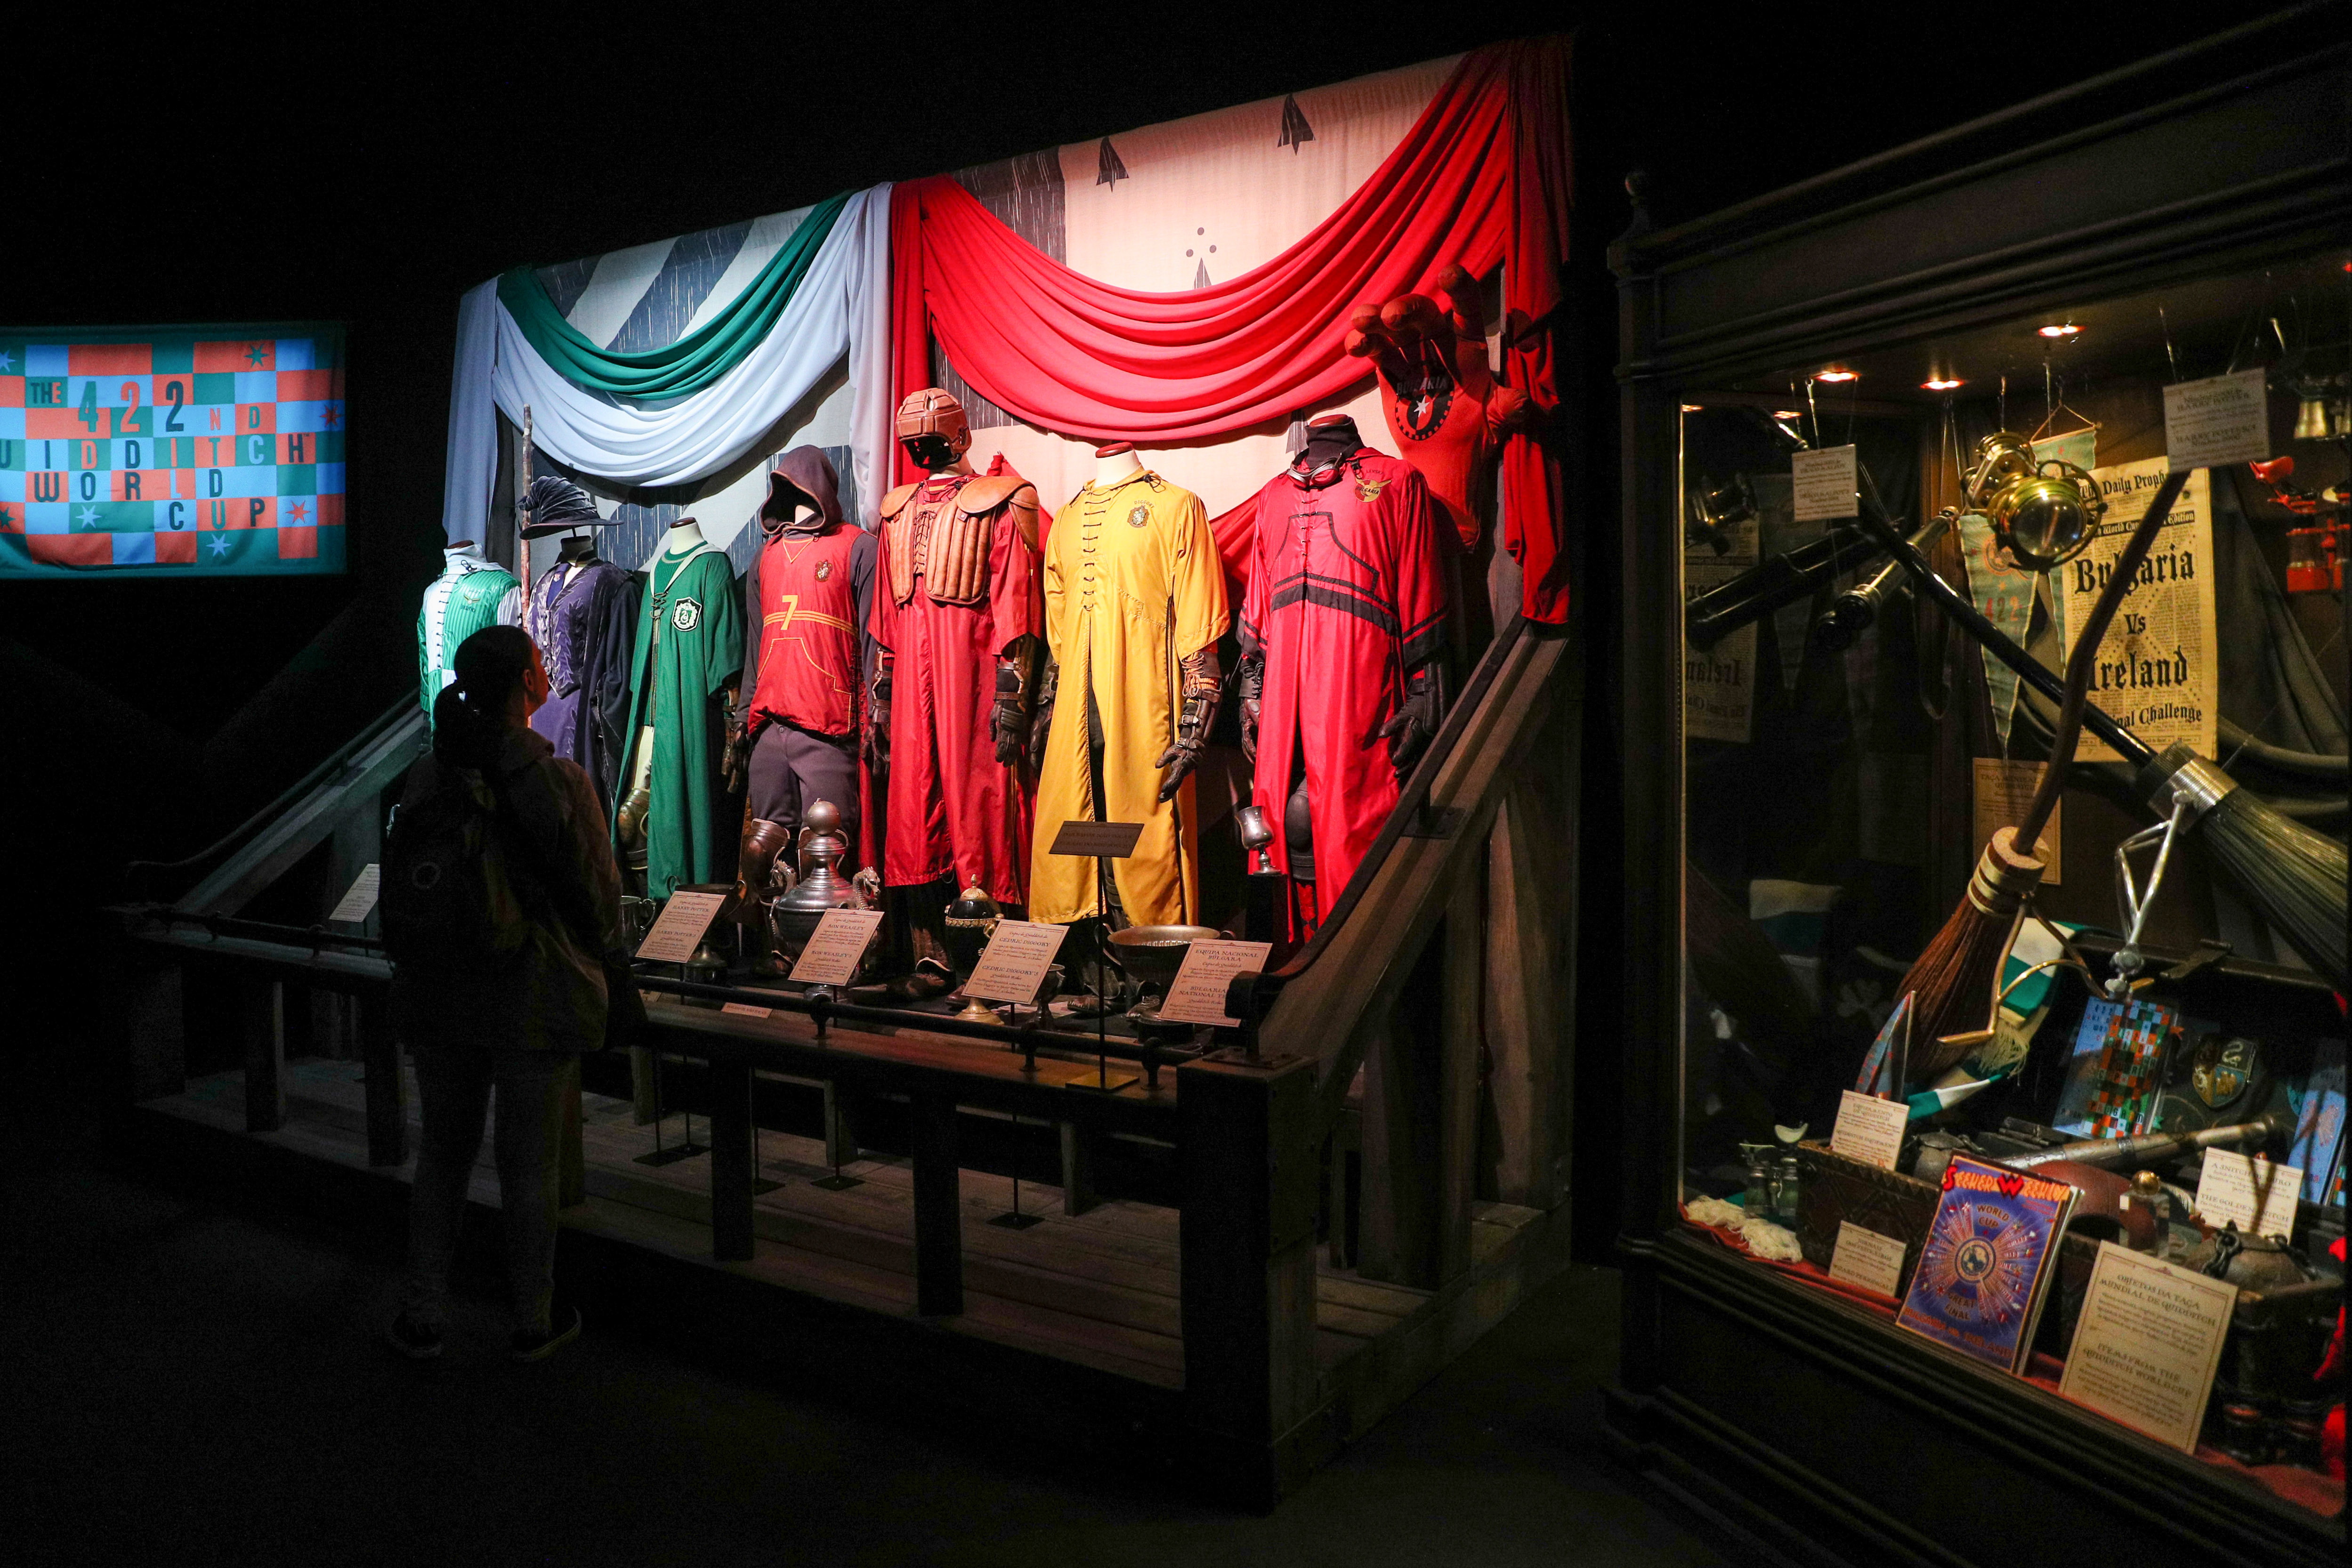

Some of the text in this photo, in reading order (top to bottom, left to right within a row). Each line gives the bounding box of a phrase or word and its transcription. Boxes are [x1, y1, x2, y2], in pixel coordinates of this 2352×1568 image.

[30, 381, 62, 404] THE
[78, 380, 261, 433] 422 ND
[34, 469, 222, 502] WORLD
[2102, 477, 2132, 495] Daily
[2134, 469, 2166, 490] Proph
[169, 498, 264, 530] CUP
[1134, 500, 1155, 508] DIGGORY
[2103, 522, 2124, 534] World
[2167, 511, 2194, 524] Edition
[2075, 543, 2194, 596] Buaria
[780, 595, 798, 630] 7
[1985, 596, 2018, 622] 422
[2124, 613, 2146, 634] Vs
[2087, 645, 2188, 691] Ireland
[2139, 703, 2202, 725] Challenge
[2219, 1164, 2252, 1177] SNITCH
[1977, 1205, 2010, 1221] WORLD
[2201, 1193, 2288, 1222] THE GOLDEN NITCH
[1979, 1216, 1999, 1229] CUP
[2116, 1273, 2156, 1293] OBJETOS
[2157, 1288, 2172, 1299] DA
[1945, 1303, 1971, 1321] FINAL
[2100, 1277, 2216, 1328] MUNDIAL DE QUIDDITCH
